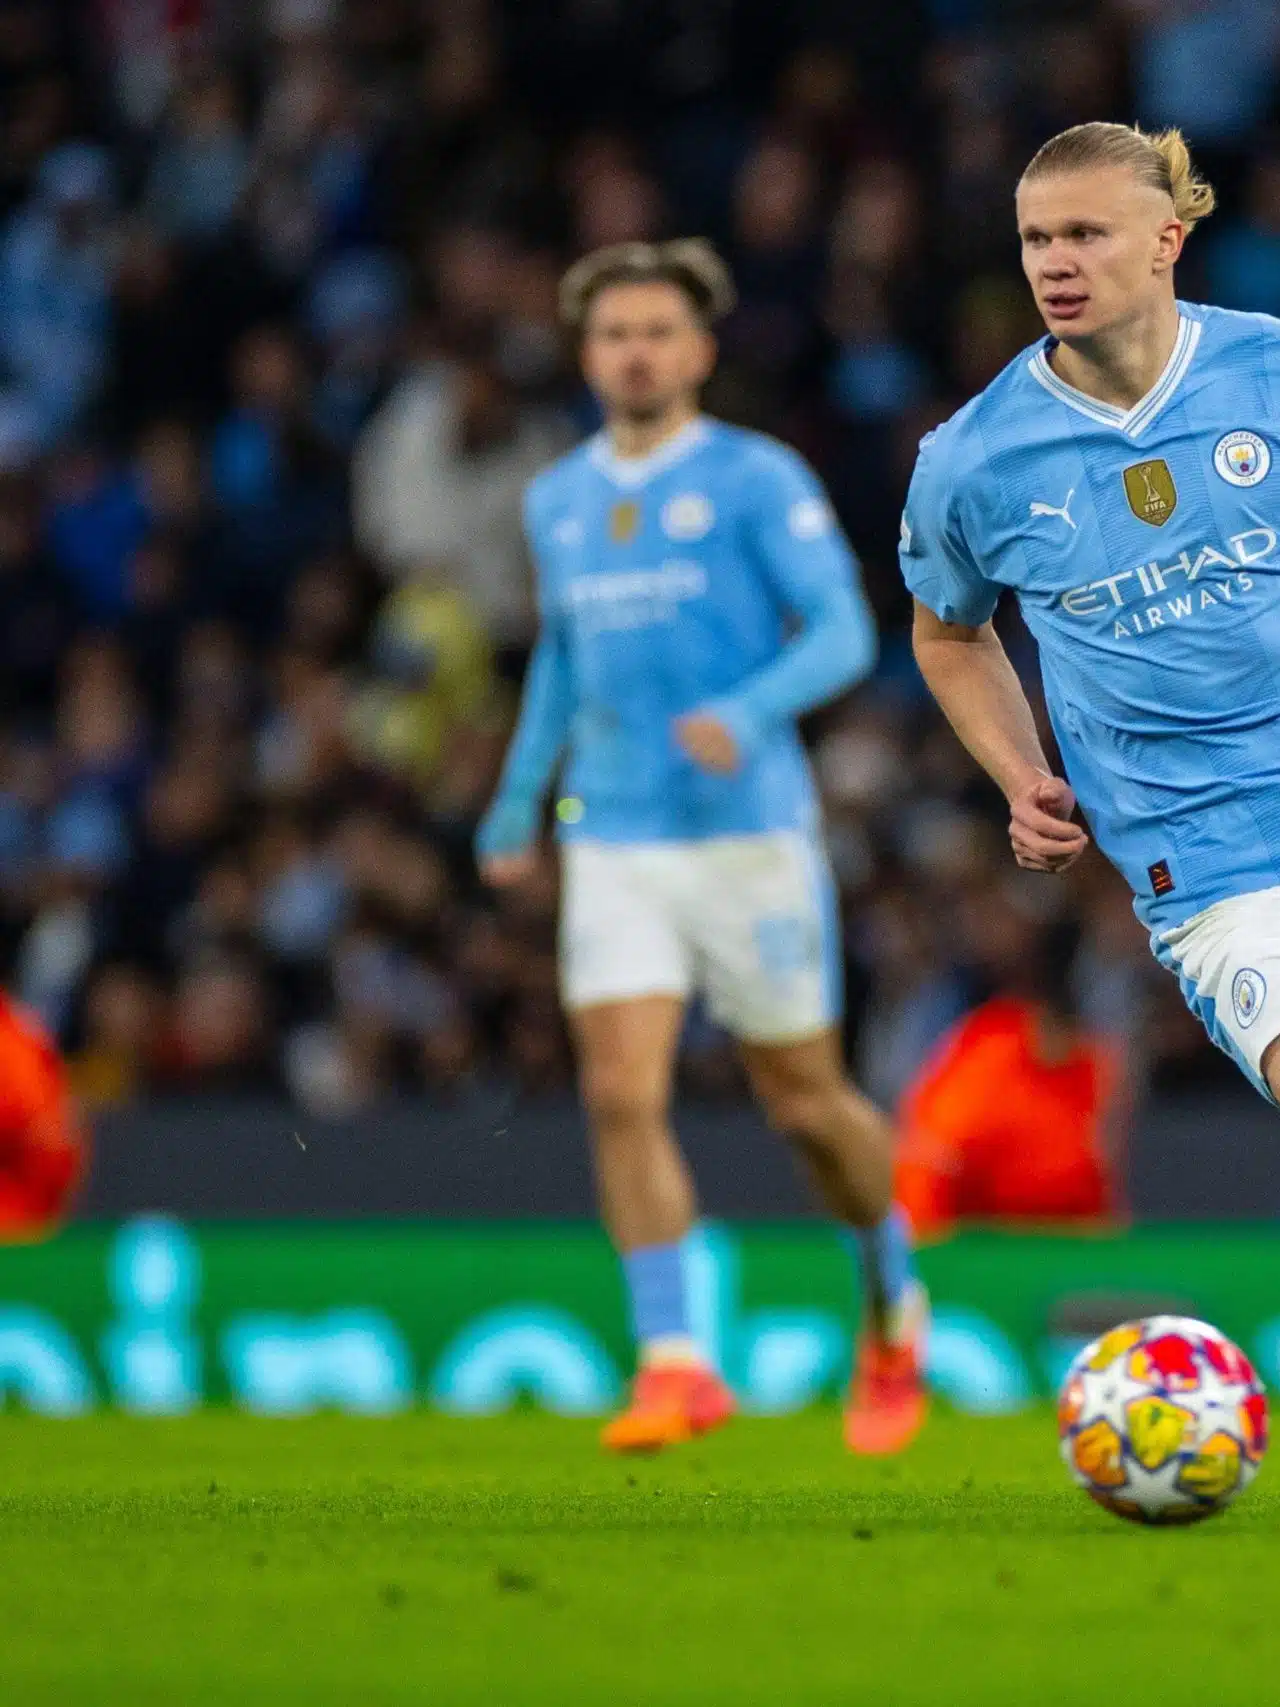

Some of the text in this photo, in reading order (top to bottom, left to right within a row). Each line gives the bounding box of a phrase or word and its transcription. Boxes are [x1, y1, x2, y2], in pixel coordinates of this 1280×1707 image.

[1144, 500, 1167, 513] FIFA
[1062, 528, 1276, 615] ETIHAD
[1114, 572, 1253, 639] AIRWAYS
